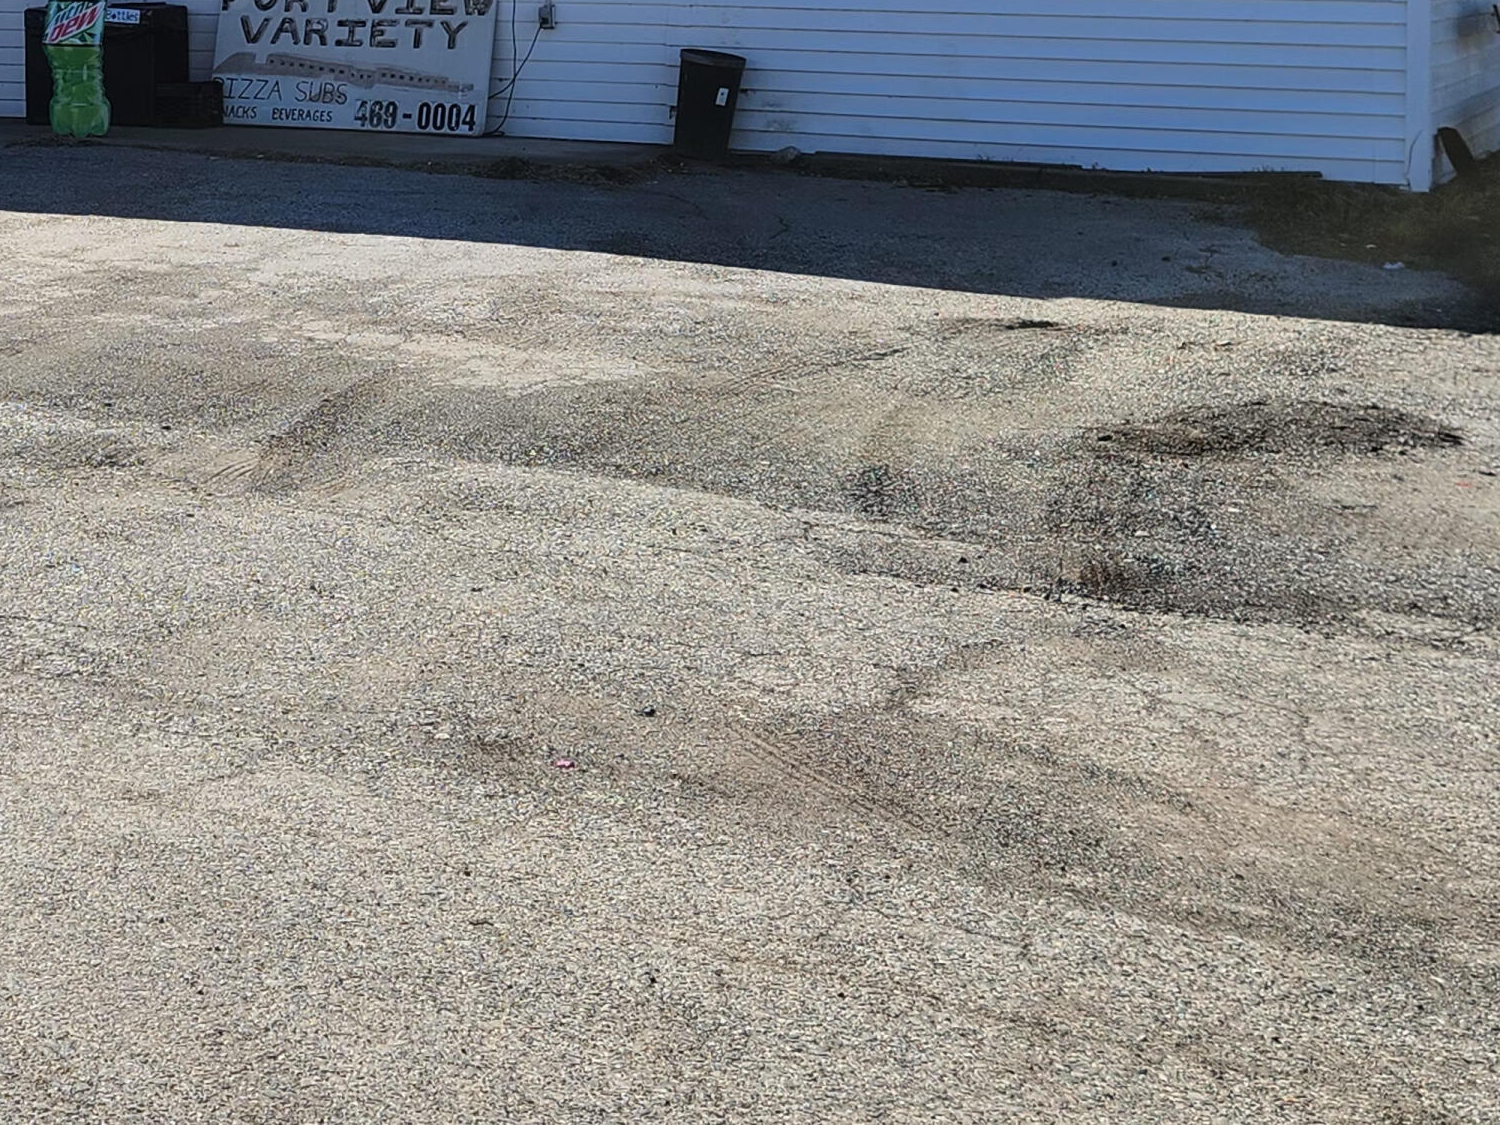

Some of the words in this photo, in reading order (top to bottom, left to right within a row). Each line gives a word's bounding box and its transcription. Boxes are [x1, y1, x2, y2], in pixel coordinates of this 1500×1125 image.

[240, 16, 469, 50] VARIETY
[294, 81, 349, 105] SUBS
[271, 107, 333, 122] BEVERAGES
